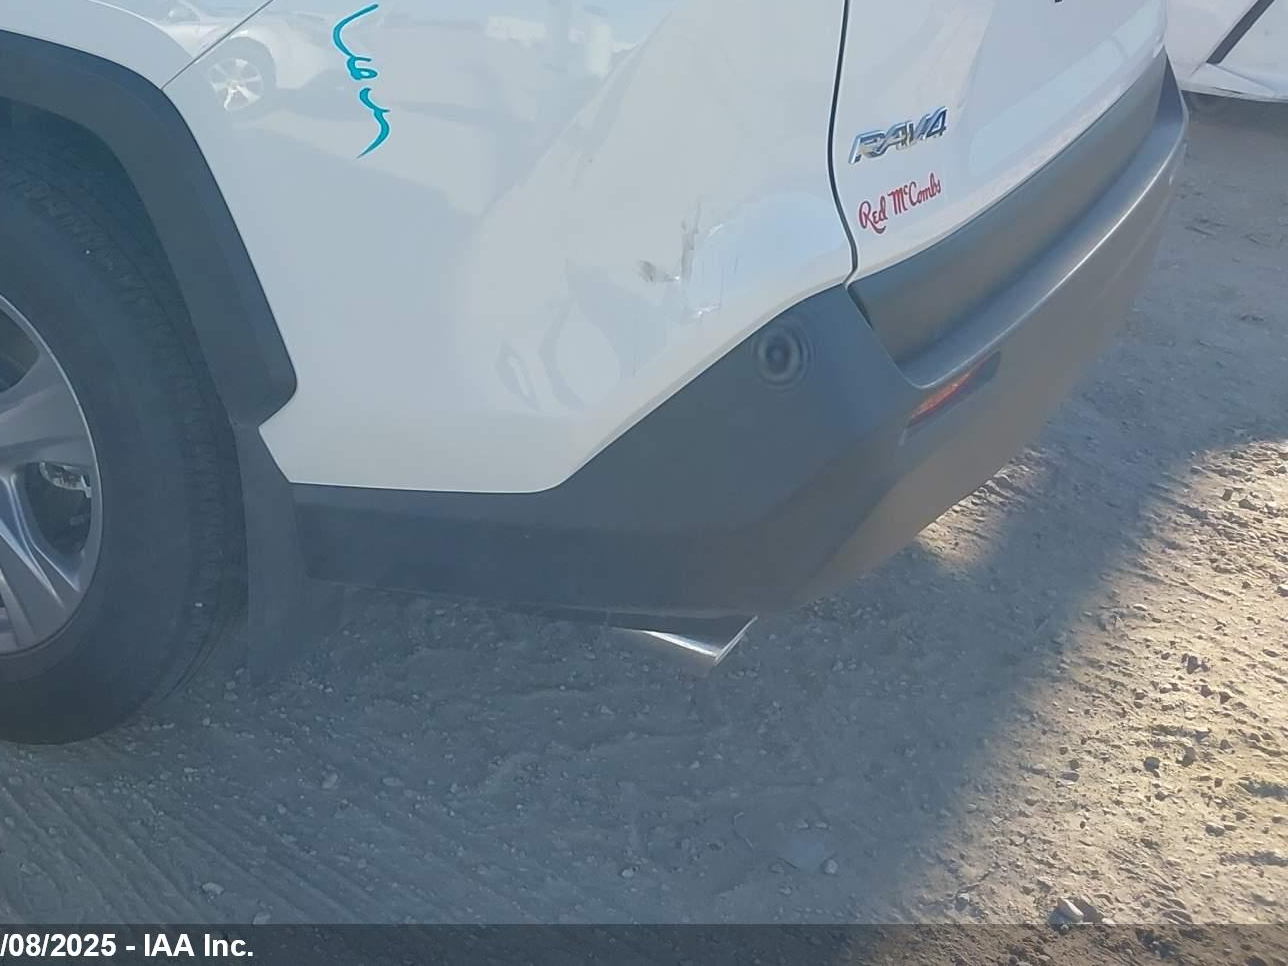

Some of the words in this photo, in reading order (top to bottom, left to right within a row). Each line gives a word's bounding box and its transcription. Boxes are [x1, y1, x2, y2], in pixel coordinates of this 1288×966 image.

[848, 106, 948, 165] RAV4
[858, 195, 889, 235] Red
[887, 172, 942, 215] McCombs
